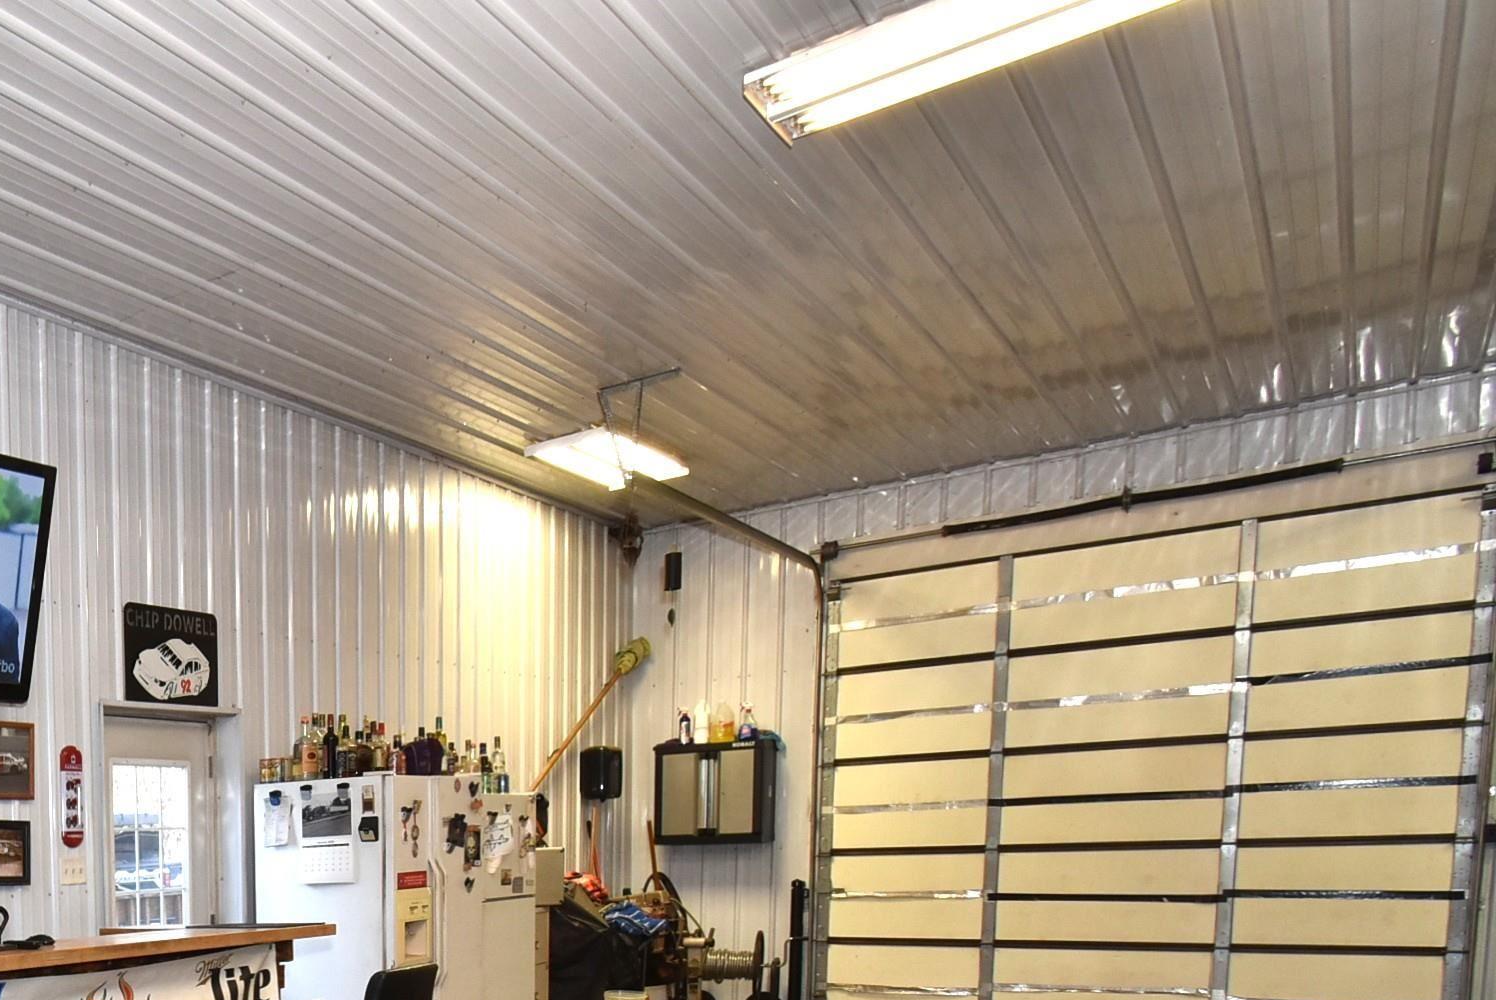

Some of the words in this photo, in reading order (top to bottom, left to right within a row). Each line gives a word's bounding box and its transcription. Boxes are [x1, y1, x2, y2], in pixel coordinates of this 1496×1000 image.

[125, 608, 160, 629] CHIP
[164, 614, 216, 637] DOWELL
[180, 678, 192, 694] 92
